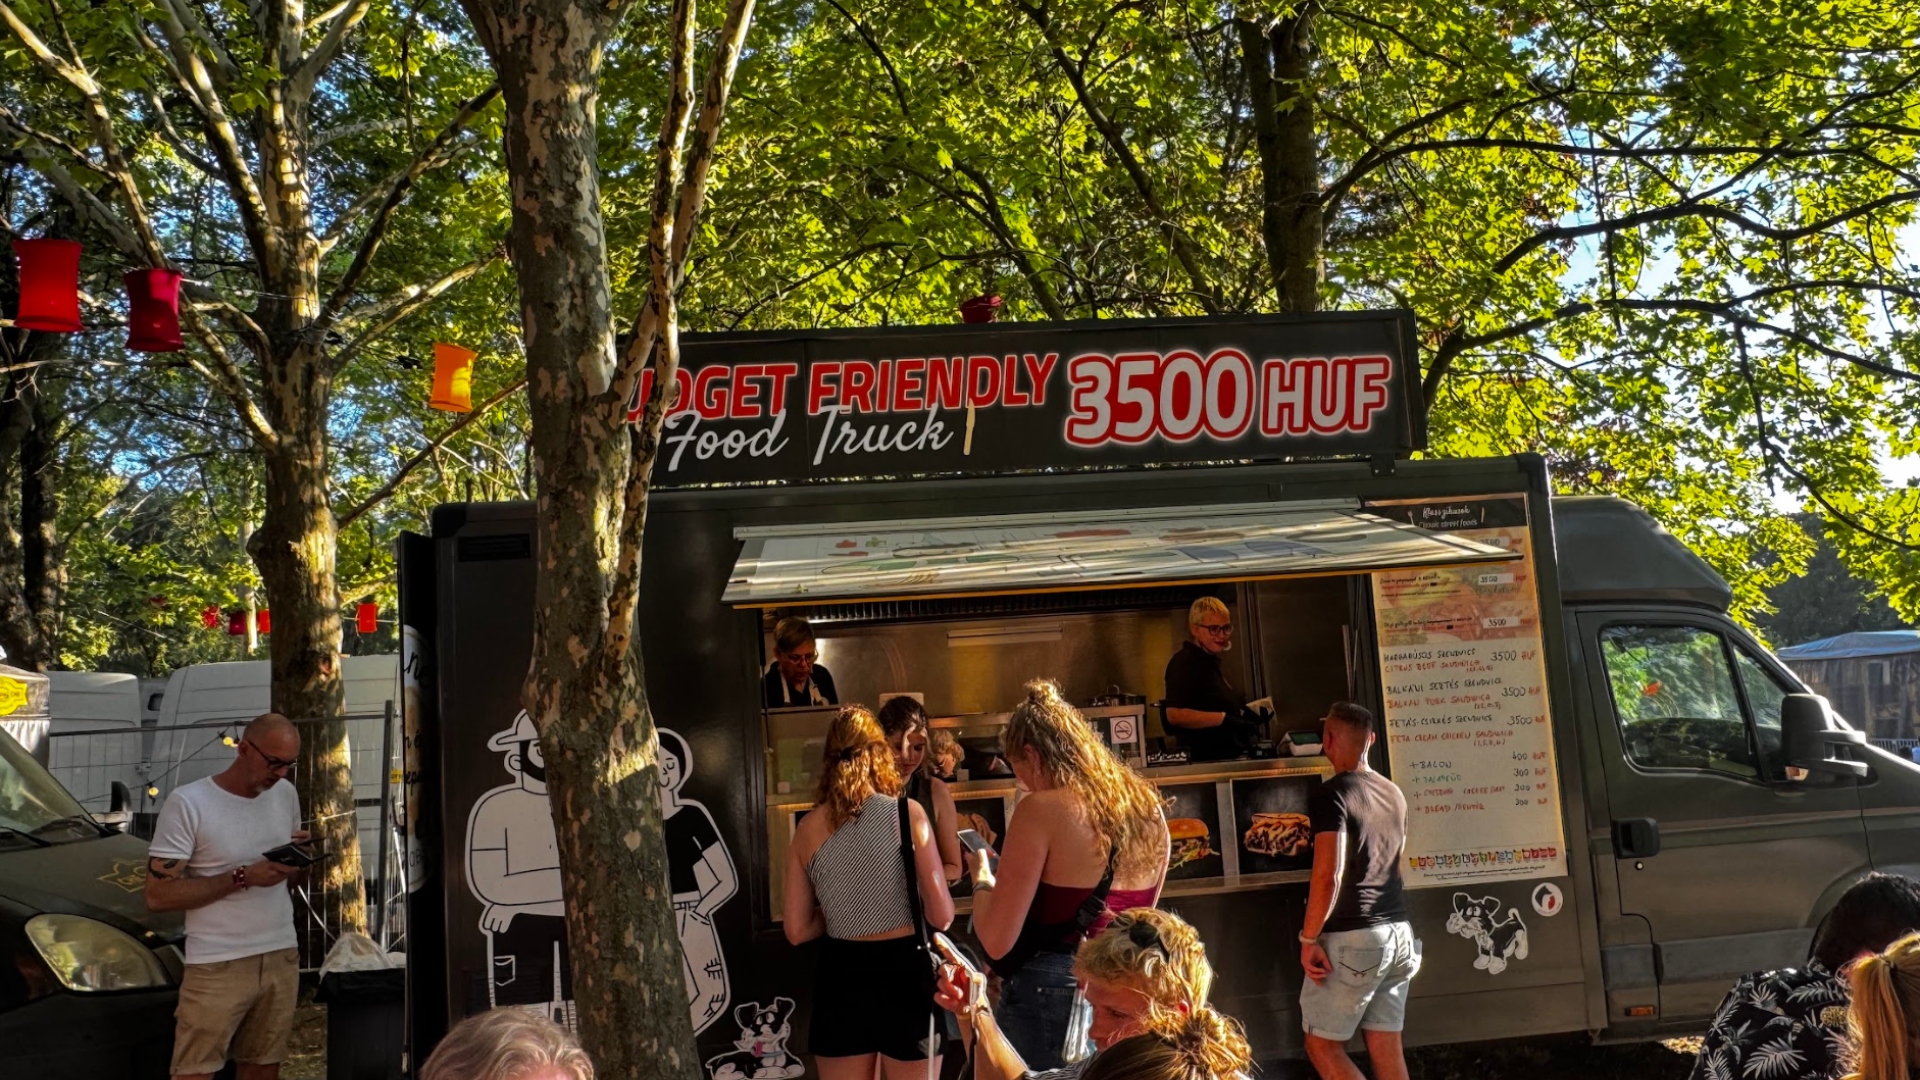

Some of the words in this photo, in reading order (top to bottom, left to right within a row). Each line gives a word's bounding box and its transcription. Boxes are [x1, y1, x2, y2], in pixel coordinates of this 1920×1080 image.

[627, 363, 798, 422] UDGET
[807, 353, 1060, 416] FRIENDLY
[1064, 347, 1257, 446] 3500
[1260, 354, 1393, 438] HUF
[664, 408, 789, 472] Food
[812, 402, 954, 466] Truck
[1488, 618, 1507, 626] 3500
[1490, 650, 1517, 661] 3500
[1521, 650, 1537, 661] HUF
[1385, 663, 1413, 673] CITRUS
[1501, 687, 1526, 697] 3500
[1506, 715, 1533, 725] 3500
[1390, 734, 1411, 744] FETA
[1512, 752, 1528, 761] 400
